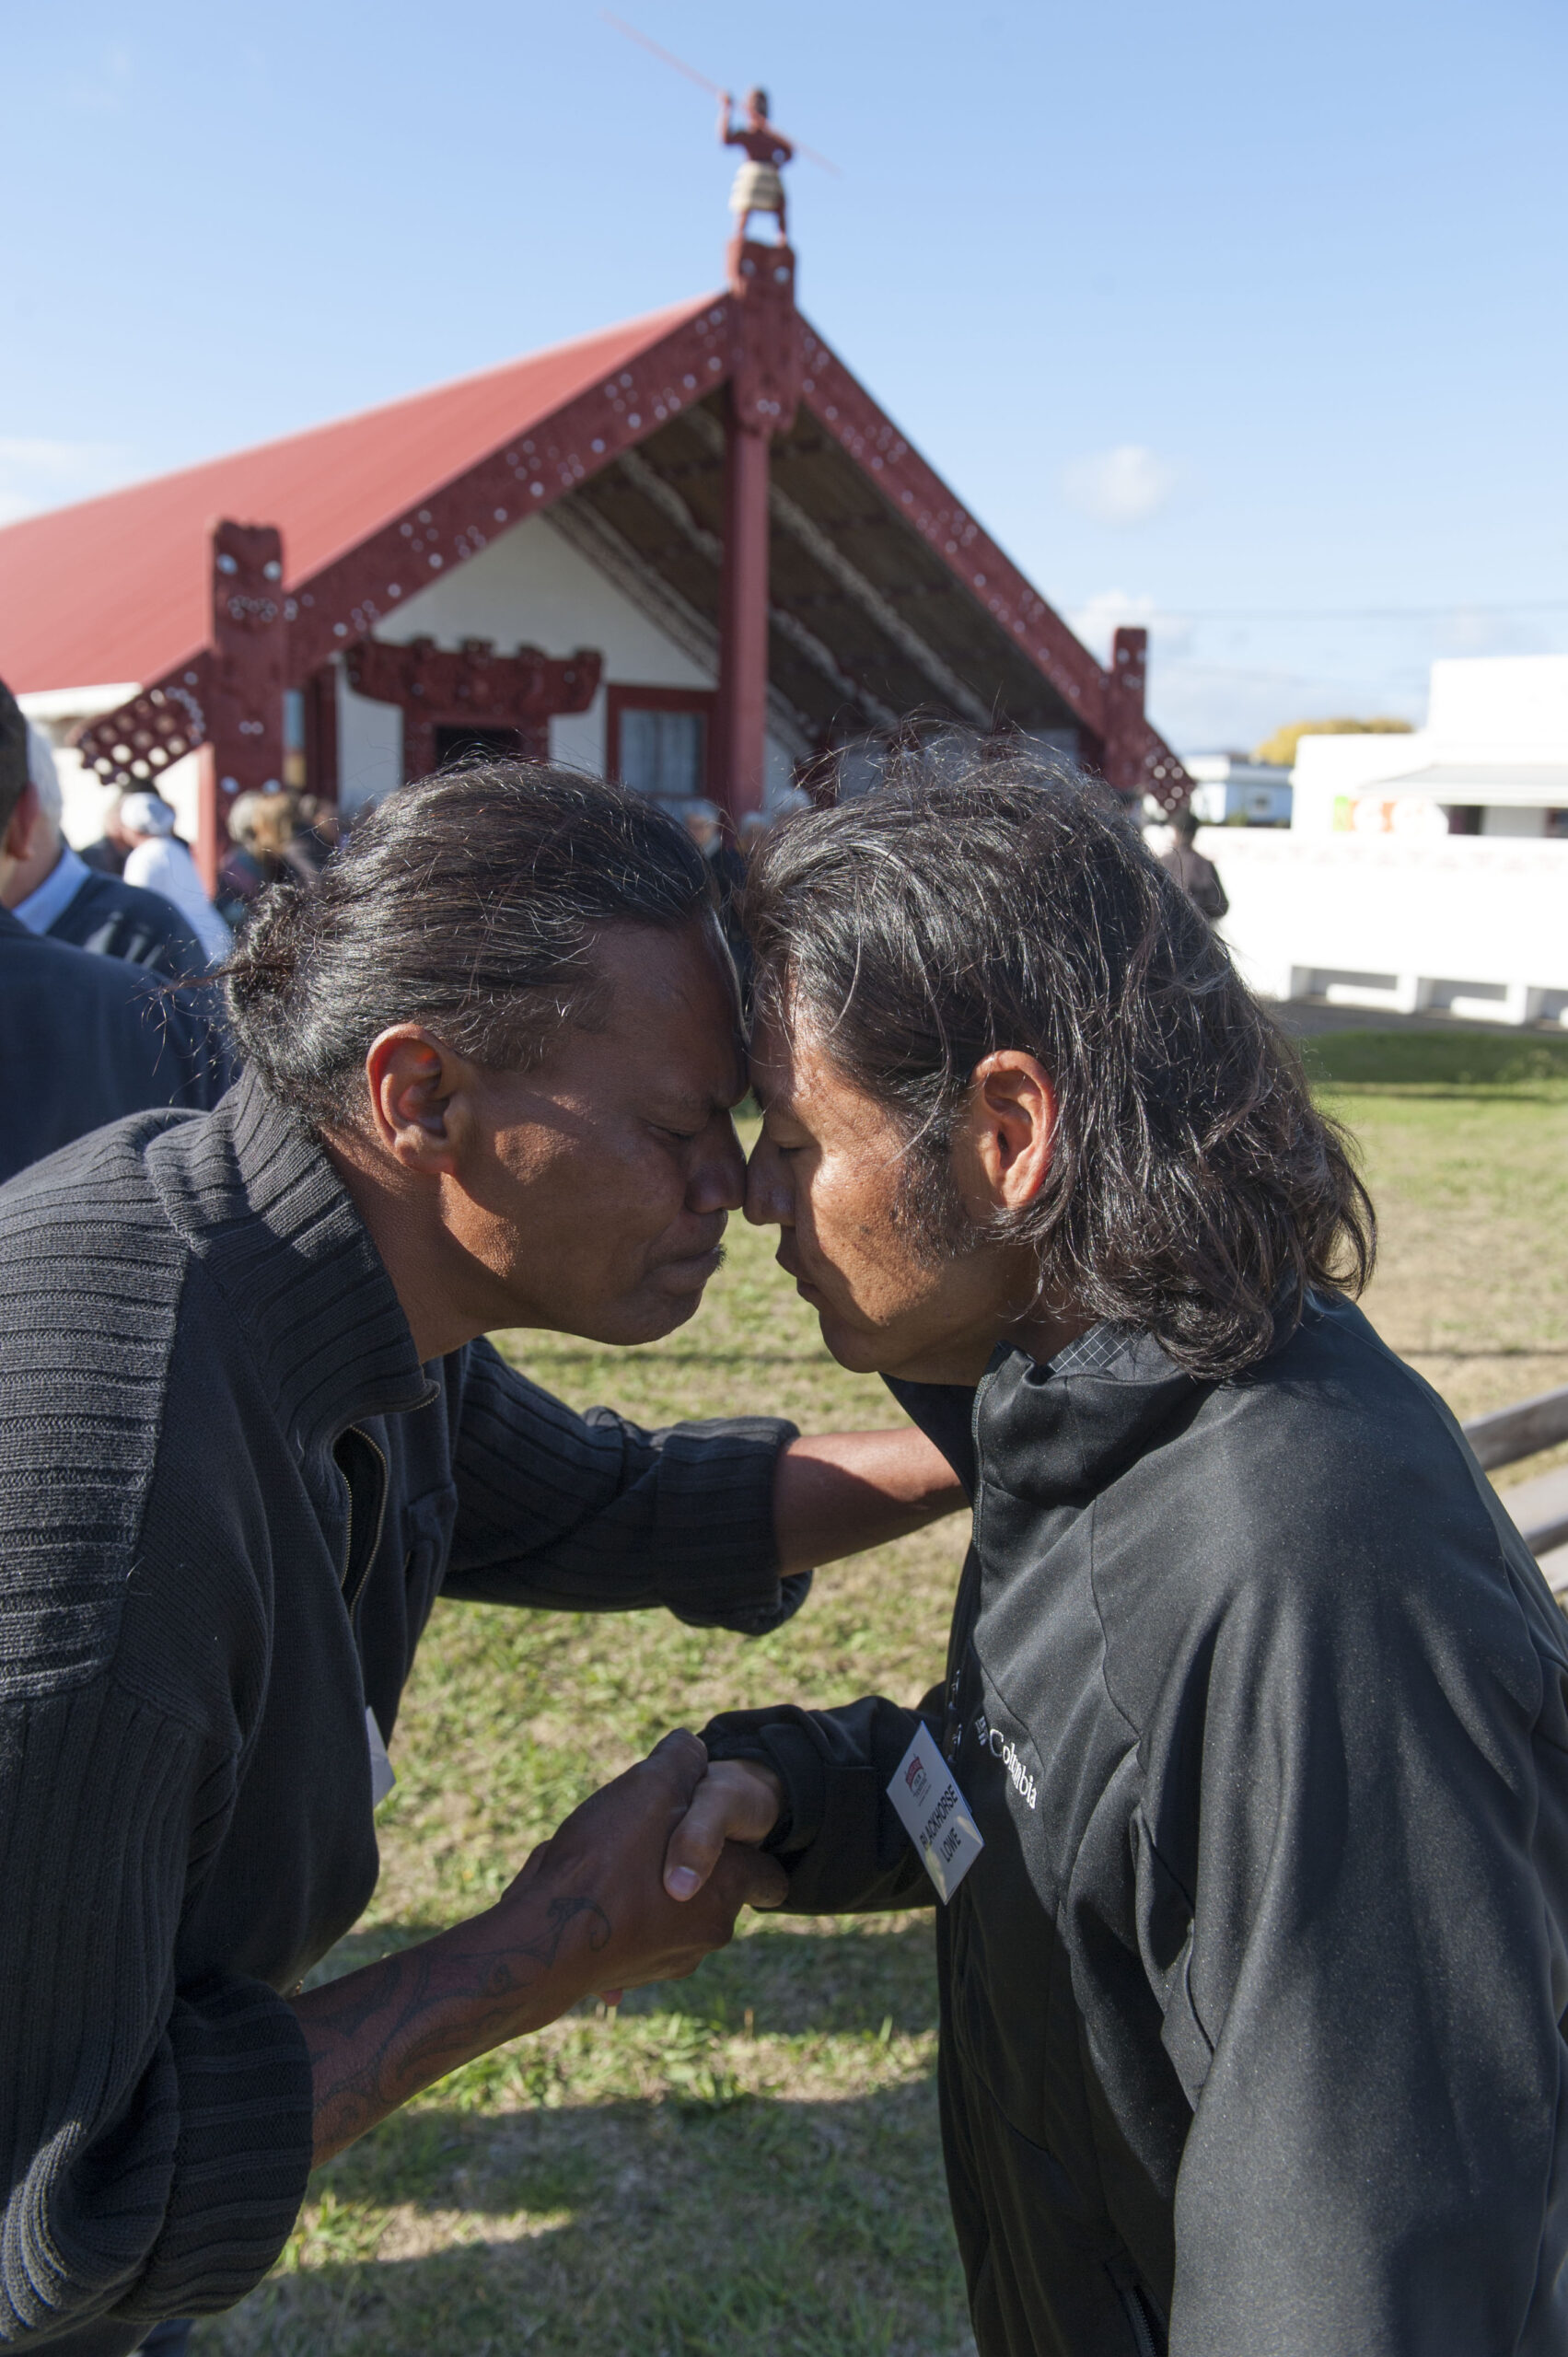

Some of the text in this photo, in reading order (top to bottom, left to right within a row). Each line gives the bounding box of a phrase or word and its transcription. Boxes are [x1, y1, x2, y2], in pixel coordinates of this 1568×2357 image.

[990, 1728, 1037, 1809] Columbia
[919, 1783, 958, 1851] BLACKHORSE
[940, 1827, 962, 1864] LOWE
